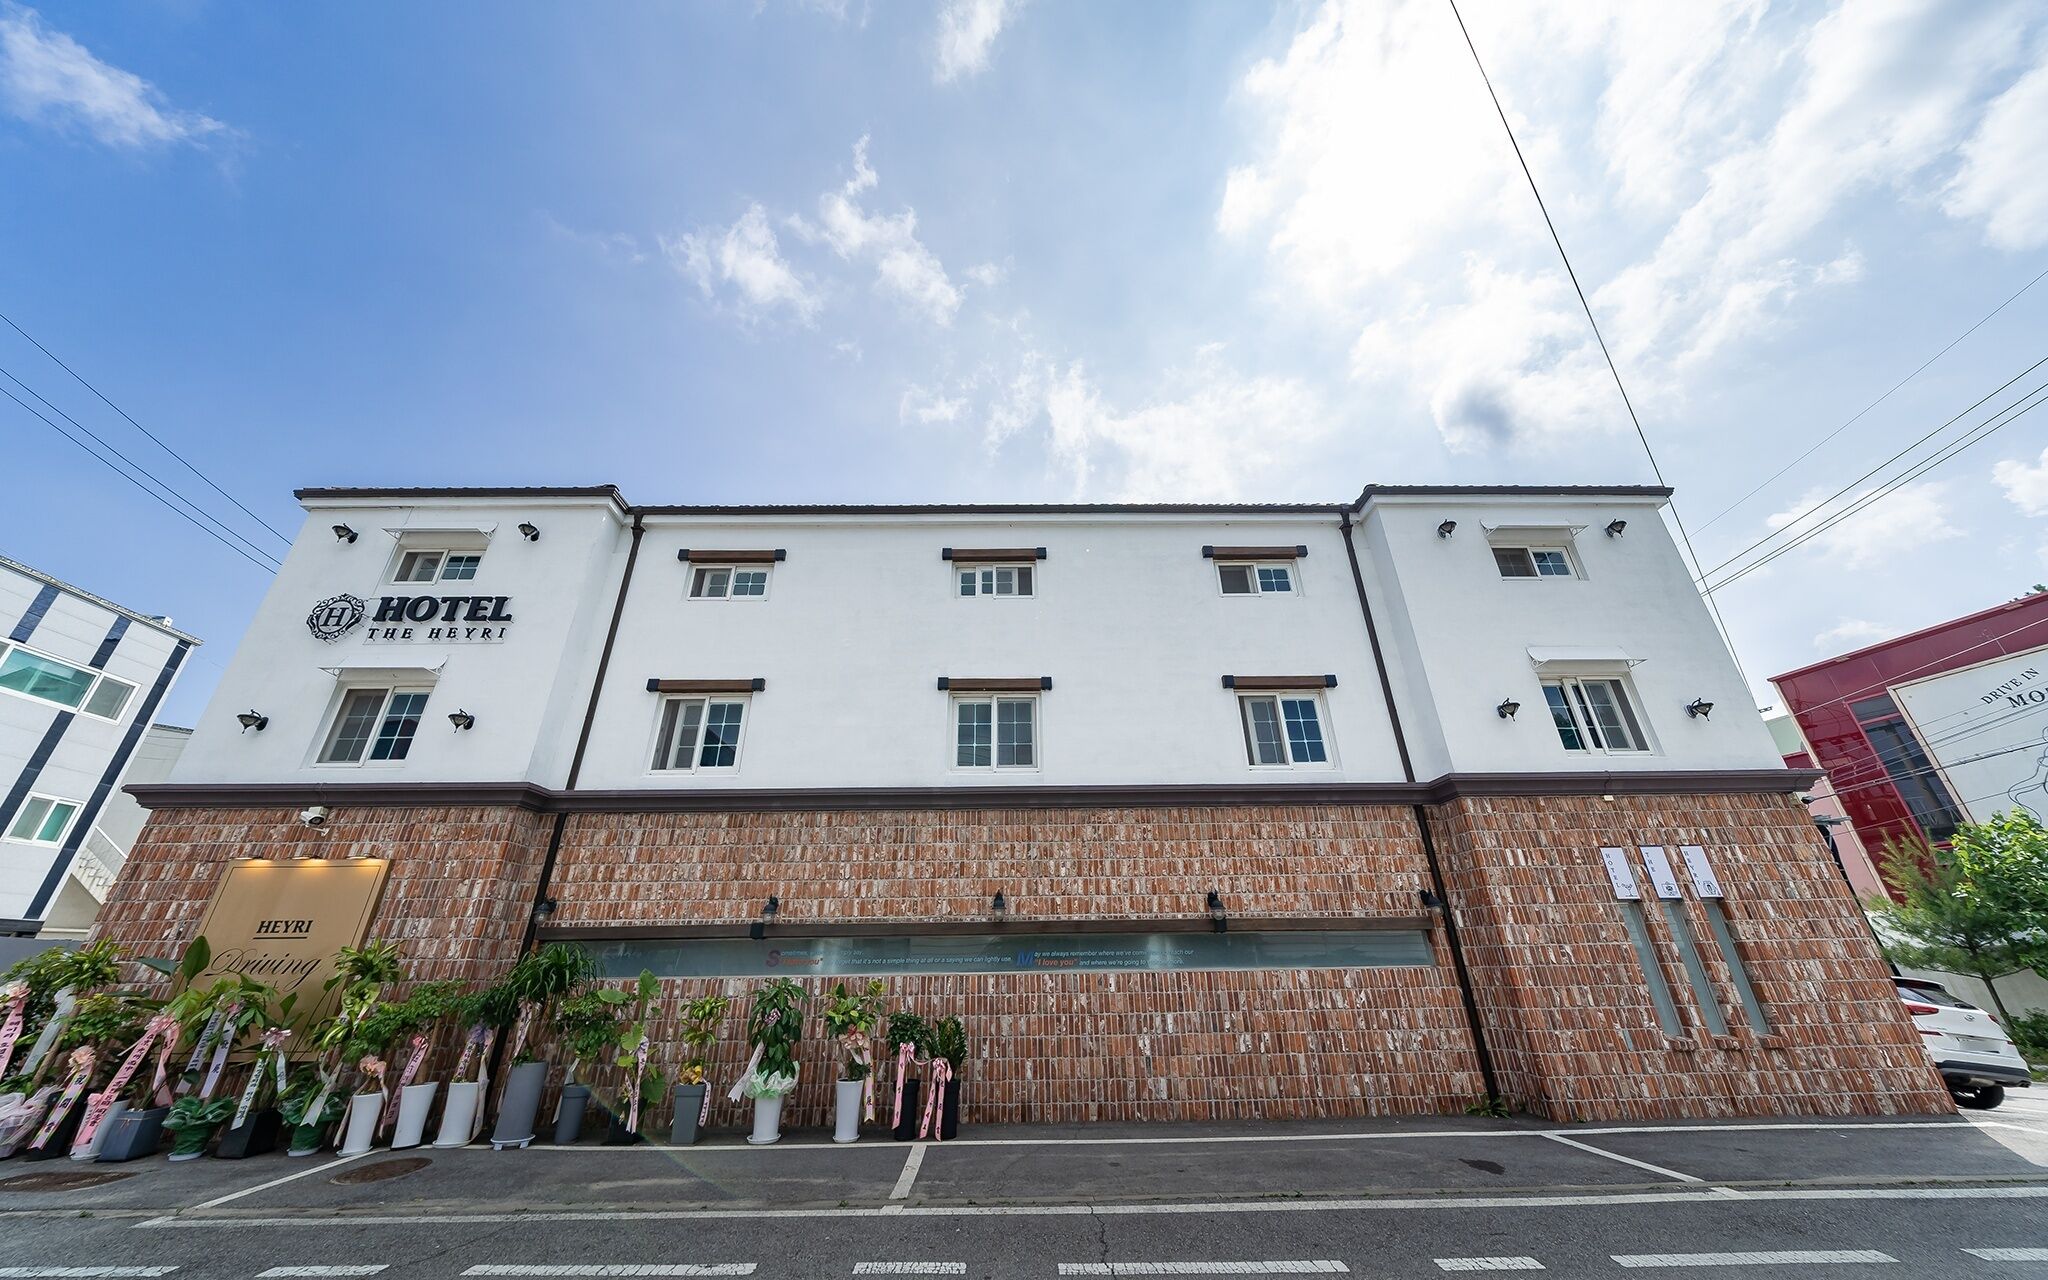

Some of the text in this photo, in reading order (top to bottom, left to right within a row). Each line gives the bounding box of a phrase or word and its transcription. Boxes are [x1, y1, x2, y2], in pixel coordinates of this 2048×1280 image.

[372, 595, 514, 623] HOTEL
[367, 627, 507, 640] THE HEYRI
[1980, 667, 2040, 705] DRIVE IN
[2006, 687, 2048, 709] MO
[1605, 852, 1622, 889] HOTEL
[1644, 851, 1657, 873] THE
[1683, 850, 1702, 887] HEYRI
[256, 919, 314, 934] HEYRI
[887, 957, 906, 966] simple
[906, 957, 920, 966] thing
[946, 957, 963, 965] saying
[974, 956, 984, 964] can
[984, 955, 1000, 964] lightly
[1043, 958, 1058, 967] love
[1079, 959, 1090, 967] and
[1090, 959, 1107, 967] where
[1108, 959, 1123, 967] we're
[1124, 960, 1139, 968] going
[1051, 950, 1070, 959] always
[1098, 949, 1115, 957] where
[204, 947, 322, 993] Driving
